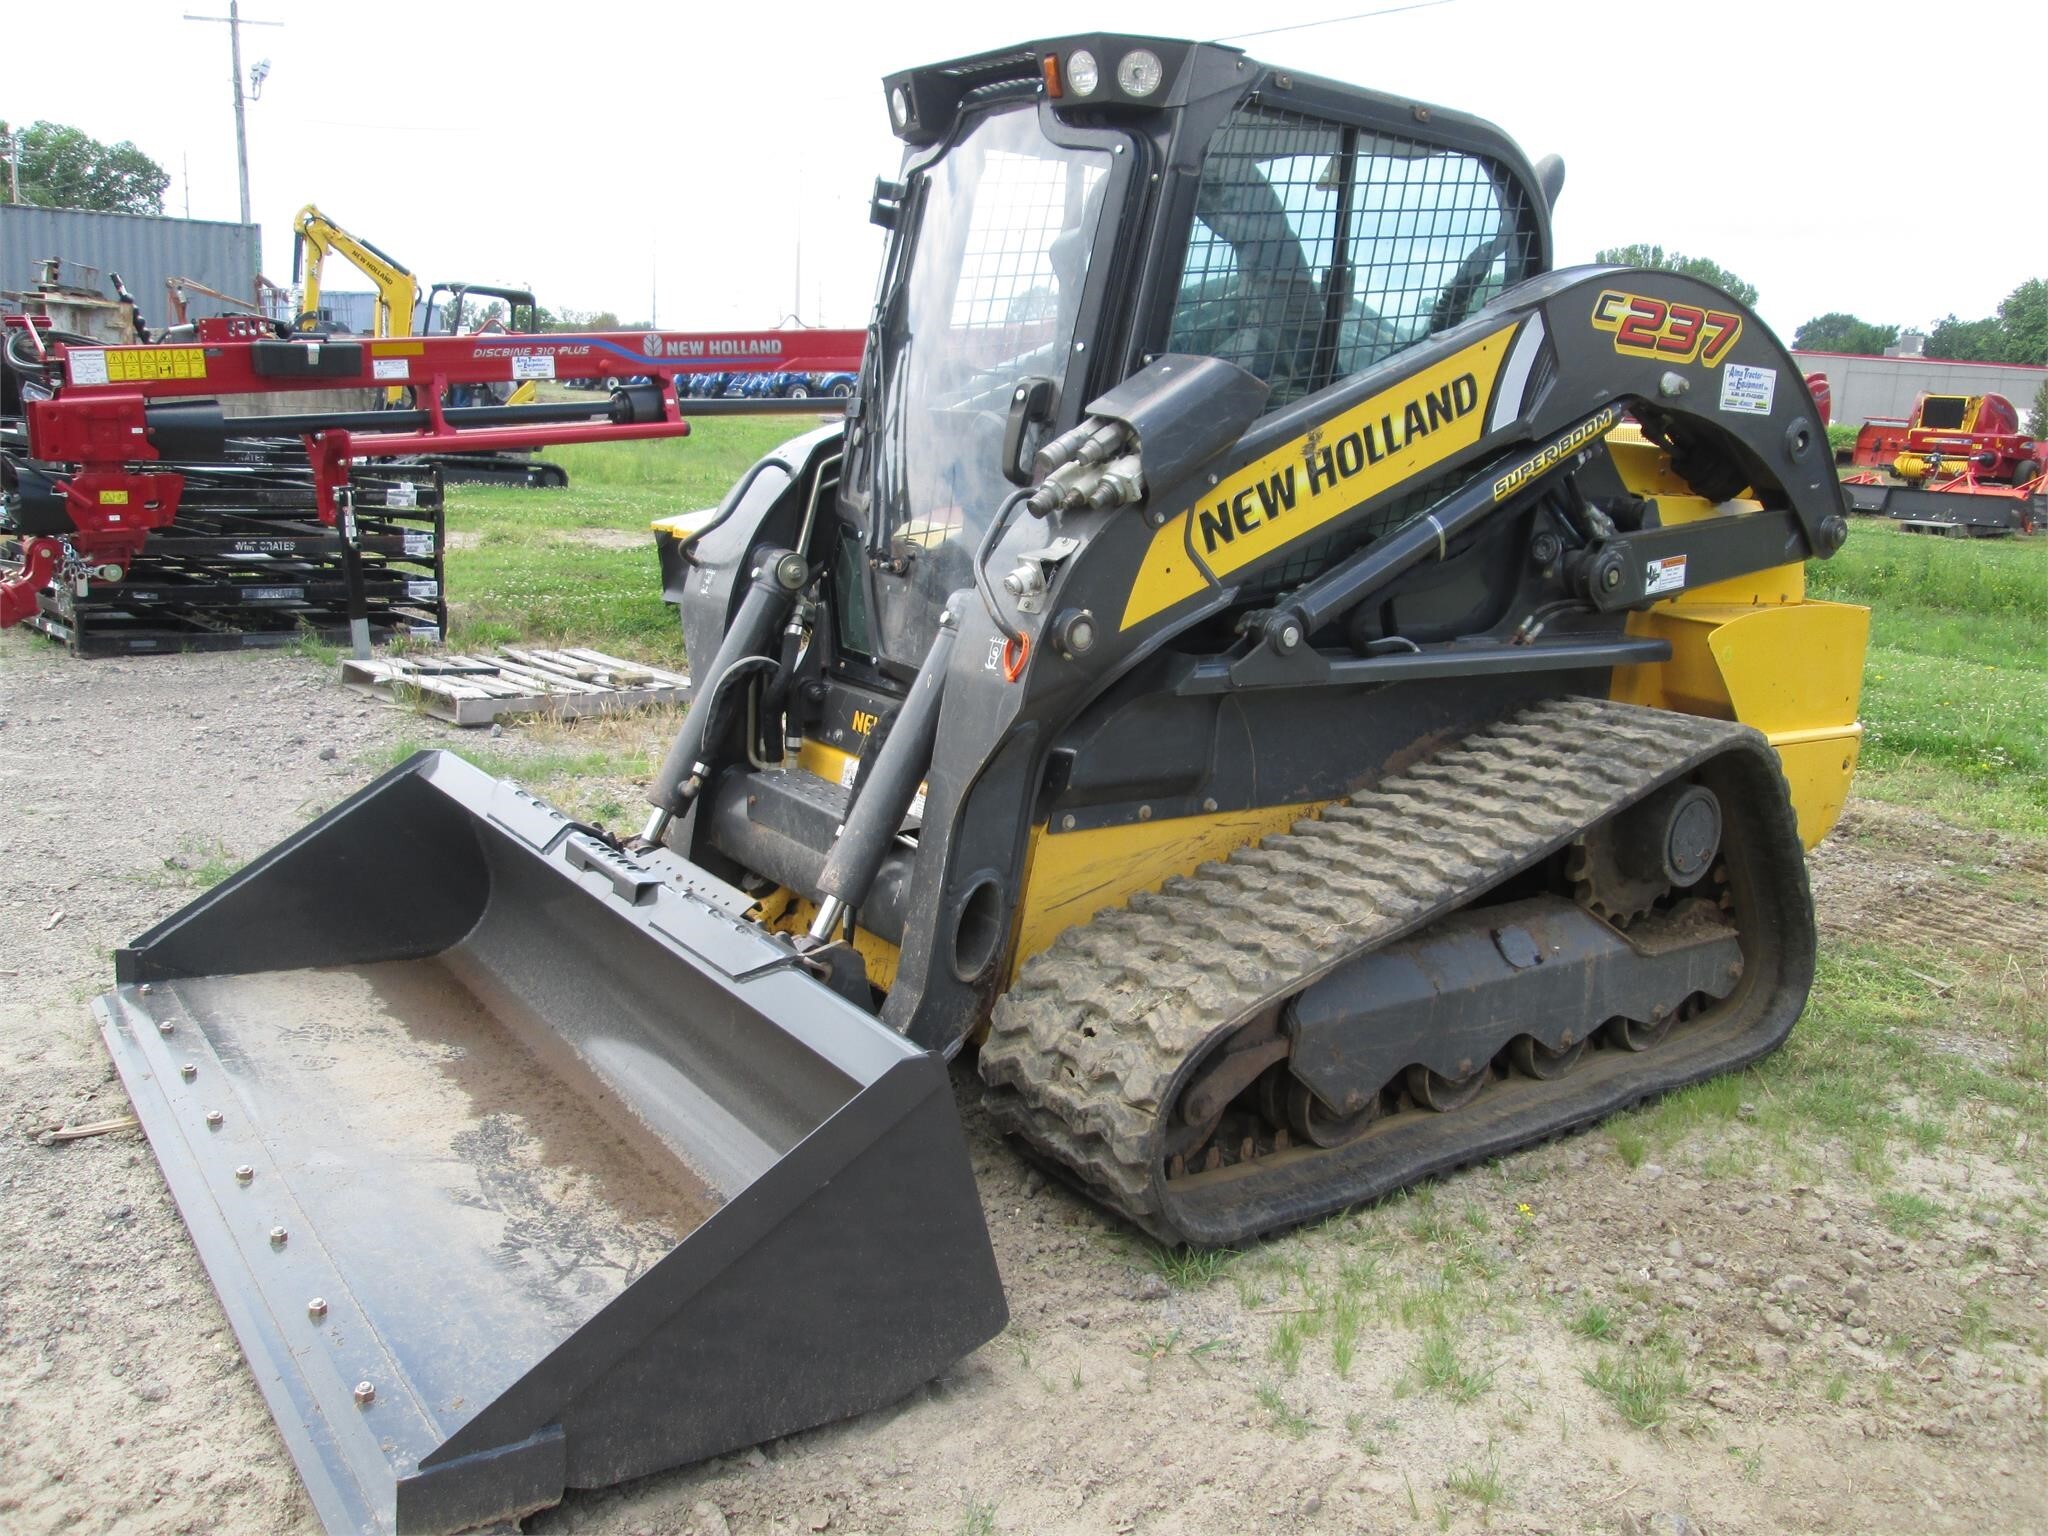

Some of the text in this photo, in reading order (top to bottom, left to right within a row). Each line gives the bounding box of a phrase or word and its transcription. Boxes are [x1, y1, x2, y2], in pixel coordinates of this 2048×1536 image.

[1592, 290, 1742, 368] C237
[473, 346, 590, 358] DISCBINE 310 PLUS
[666, 339, 782, 356] NEW HOLLAND
[1736, 377, 1765, 390] Equipment
[1743, 367, 1762, 380] Tractor
[1199, 372, 1478, 554] NEW HOLLAND
[1494, 408, 1612, 501] SUPER BOOM
[852, 710, 879, 736] NE
